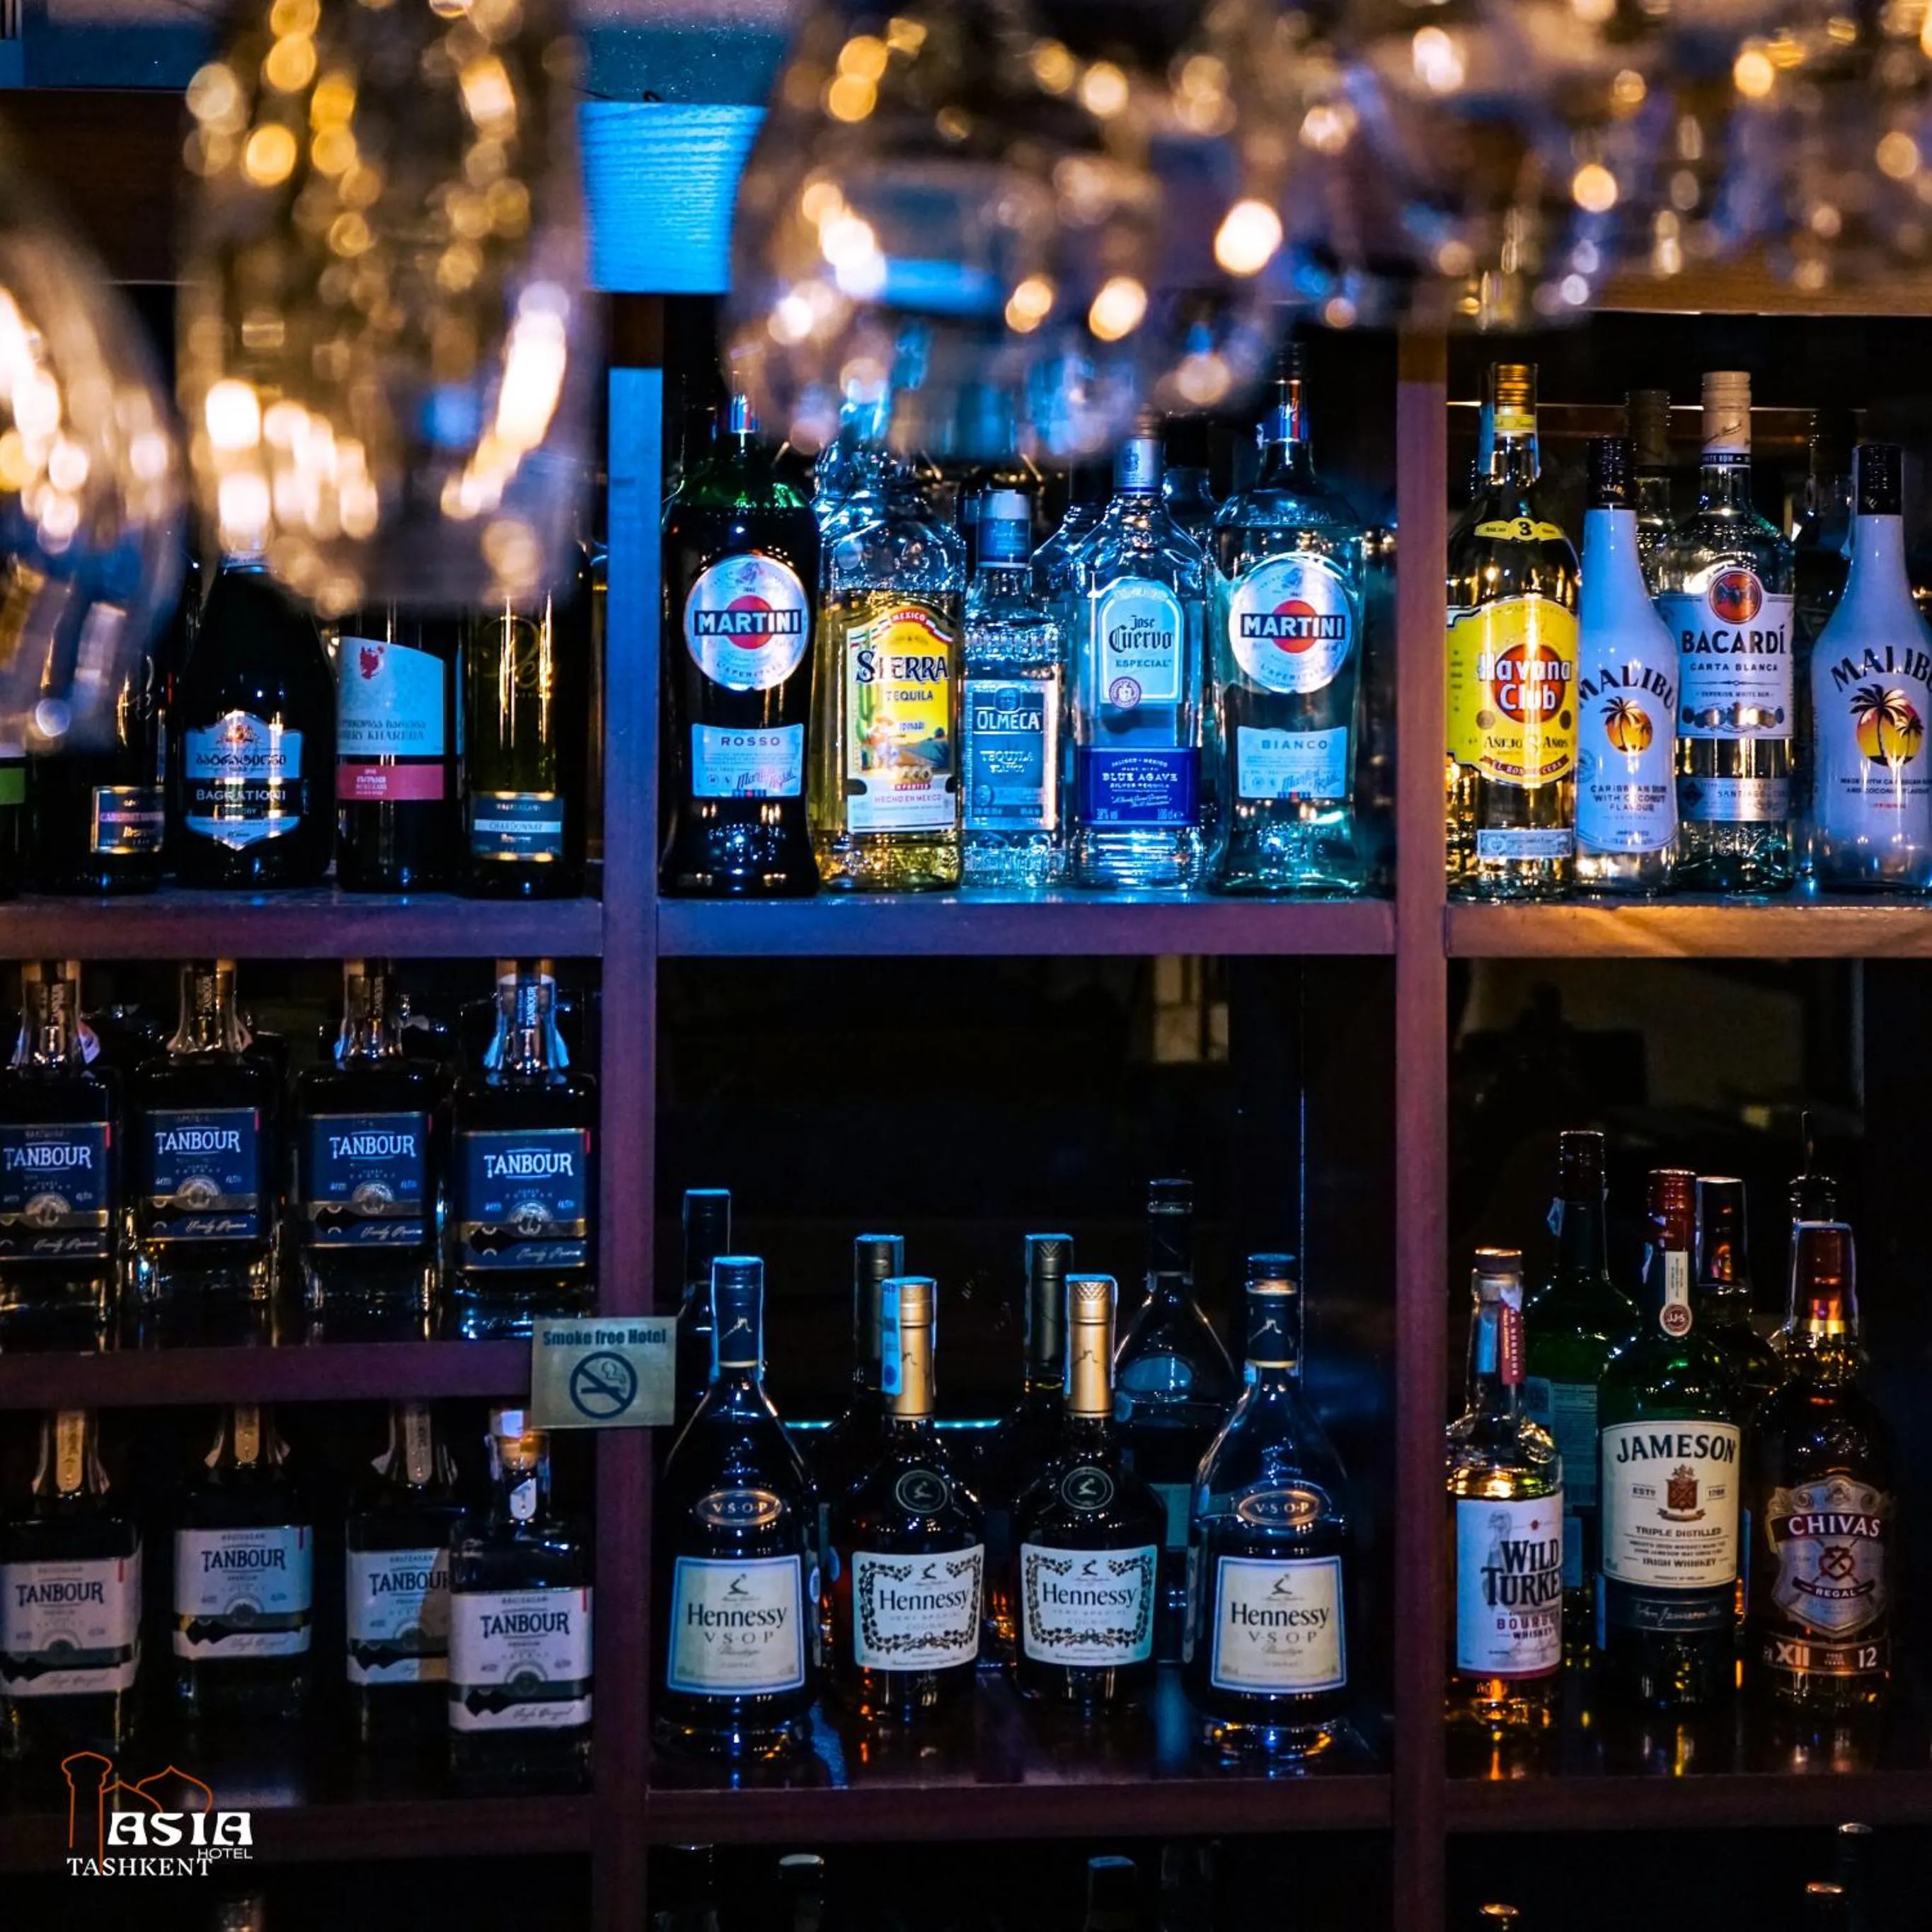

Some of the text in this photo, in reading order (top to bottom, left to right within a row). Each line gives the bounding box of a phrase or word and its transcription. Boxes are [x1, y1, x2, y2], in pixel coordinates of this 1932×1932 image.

[1518, 521, 1532, 536] 3
[698, 612, 799, 633] MARTINI
[1130, 615, 1155, 630] Jose
[1243, 616, 1342, 637] MARTINI
[1108, 625, 1172, 653] Cuervo
[1681, 625, 1786, 654] BACARDÍ
[856, 650, 949, 683] SIERRA
[1115, 659, 1169, 668] ESPECIAL
[1478, 652, 1572, 682] Havana
[1690, 663, 1778, 672] CARTA BLANCA
[887, 689, 933, 701] TEQUILA
[1500, 683, 1556, 710] Club
[1577, 665, 1676, 710] MALIBU
[977, 711, 1040, 730] OLMECA
[720, 736, 781, 747] ROSSO
[1260, 740, 1328, 750] BIANCO
[1102, 772, 1178, 782] BLUE AGAVE
[1590, 784, 1650, 793] CARIBBAN
[196, 789, 286, 801] BAGRATIONI
[1594, 794, 1666, 803] WITH CCONUT
[154, 1130, 241, 1155] TANBOUR
[328, 1134, 416, 1159] TANBOUR
[3, 1146, 92, 1171] TANBOUR
[483, 1152, 574, 1178] TANBOUR
[543, 1328, 667, 1346] Smoke free Hotel
[1616, 1434, 1735, 1464] JAMESON
[1635, 1525, 1672, 1536] TRIPLE
[1788, 1514, 1881, 1538] CHIVAS
[201, 1548, 287, 1573] TANBOUR
[1500, 1537, 1559, 1575] WILD
[1674, 1558, 1717, 1568] WHISKEY
[16, 1582, 104, 1607] TANBOUR
[1042, 1582, 1138, 1609] Hennessy
[1480, 1564, 1562, 1608] TURKE
[1815, 1587, 1858, 1597] REGAL
[879, 1587, 970, 1611] Hennessy
[480, 1612, 570, 1639] TANBOUR
[687, 1602, 788, 1629] Hennessy
[1230, 1602, 1330, 1629] Hennessy
[1496, 1613, 1560, 1630] BOURBO
[1776, 1640, 1810, 1667] XII
[1858, 1647, 1878, 1669] 12
